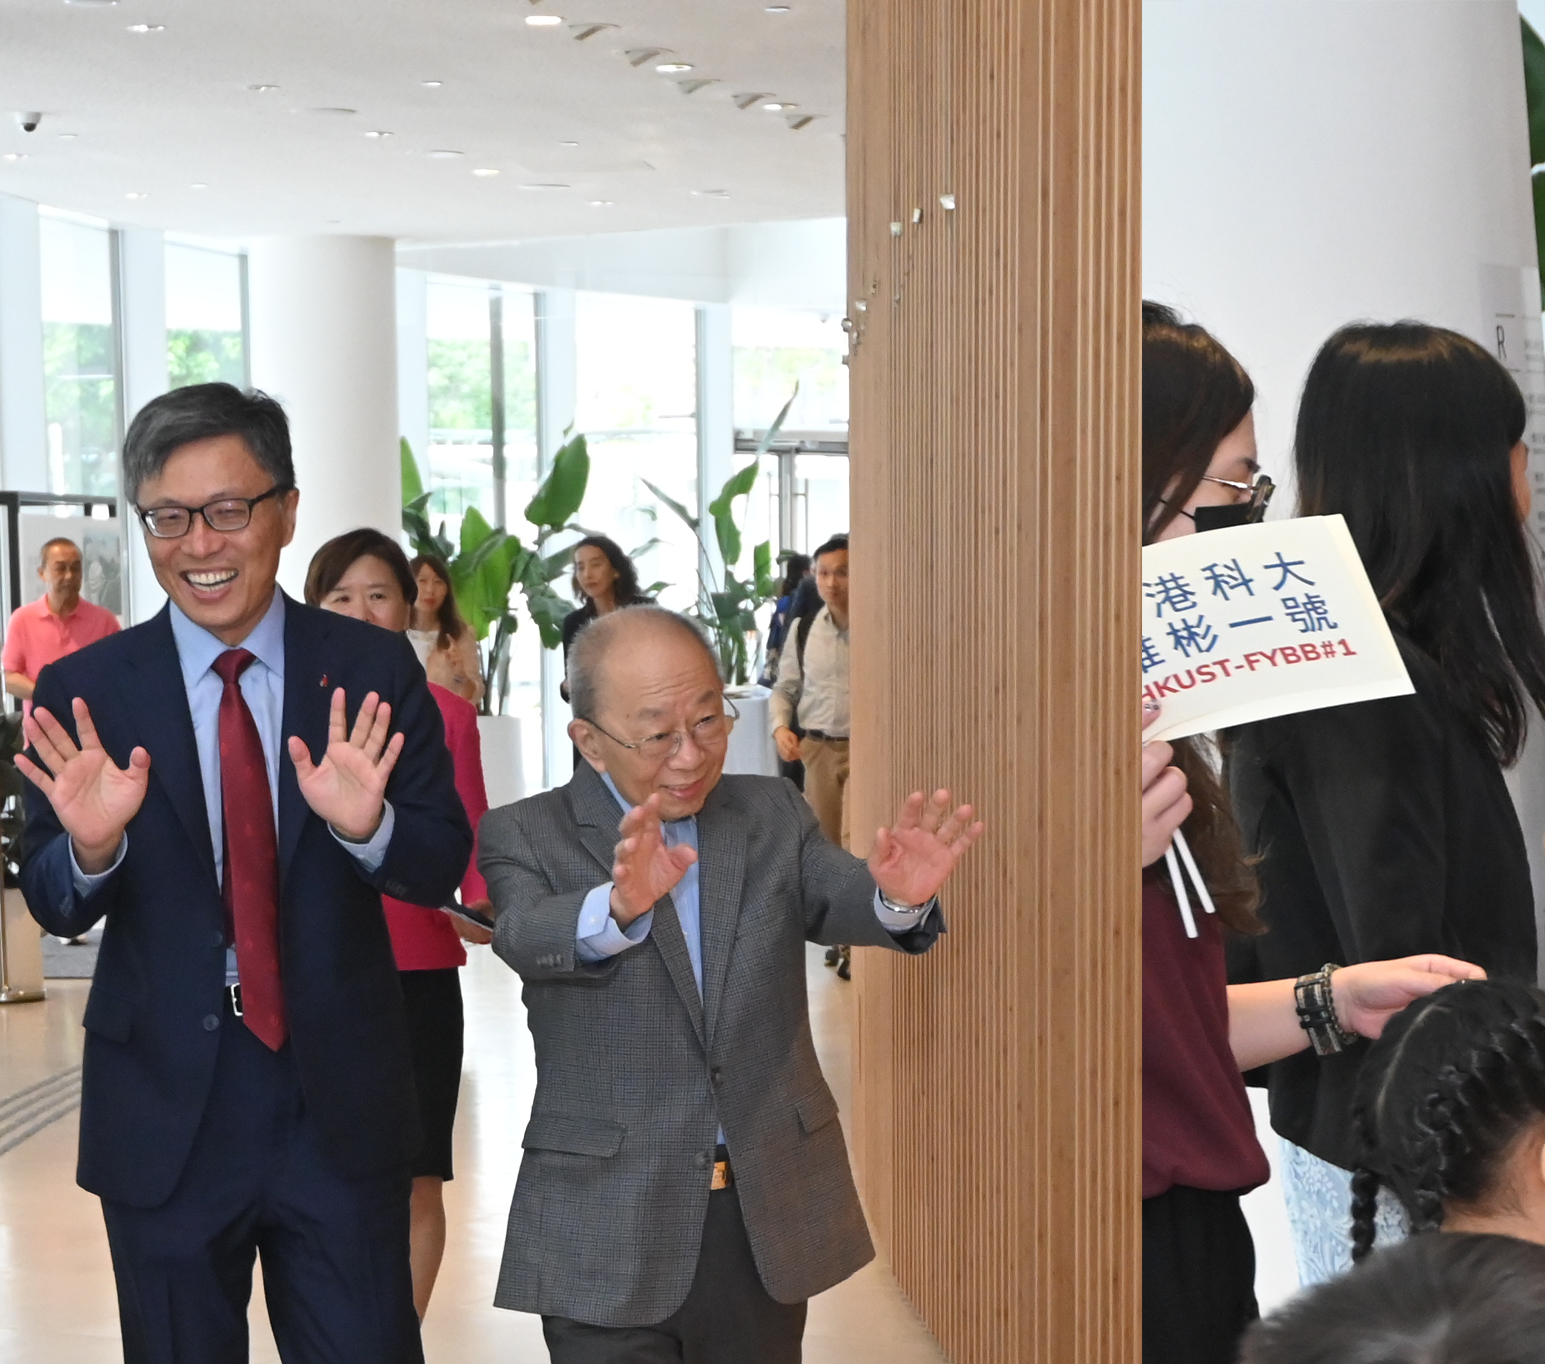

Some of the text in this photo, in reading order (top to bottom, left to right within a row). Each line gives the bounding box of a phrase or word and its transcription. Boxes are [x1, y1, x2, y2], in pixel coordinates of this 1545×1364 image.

[1143, 552, 1316, 618] 港科大
[1142, 638, 1358, 702] HKUST-FYBB#1
